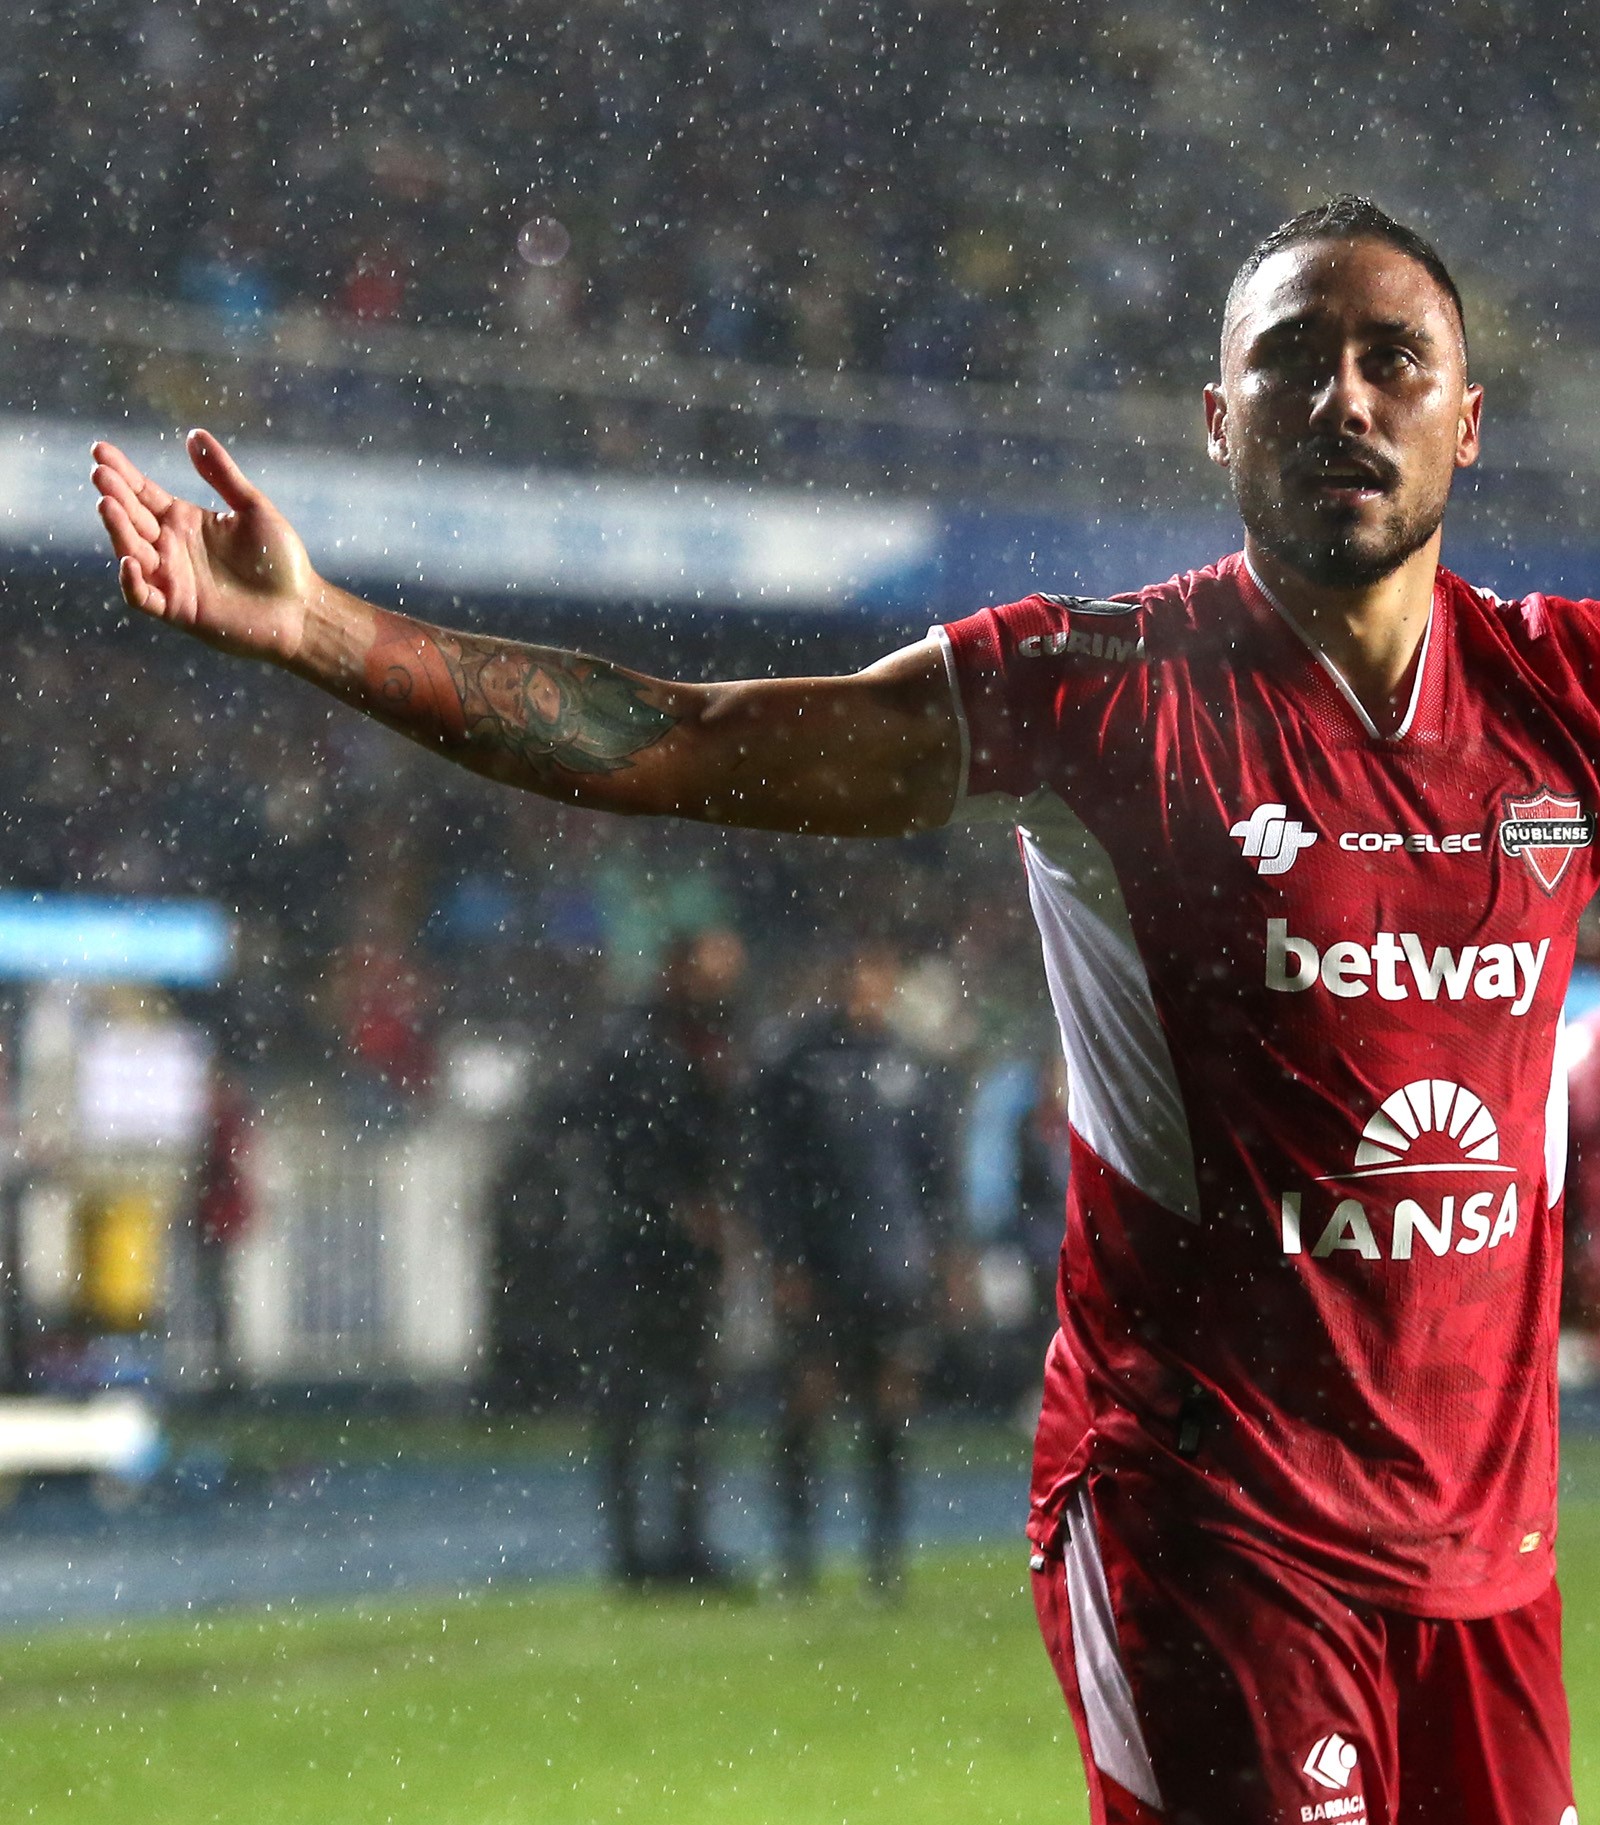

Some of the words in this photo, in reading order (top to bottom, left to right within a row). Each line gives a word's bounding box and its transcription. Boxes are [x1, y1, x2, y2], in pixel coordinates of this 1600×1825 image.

[1339, 832, 1482, 853] COPELEC
[1505, 825, 1589, 842] ÑUBLENSE
[1265, 918, 1551, 1017] betway
[1281, 1182, 1519, 1261] IANSA
